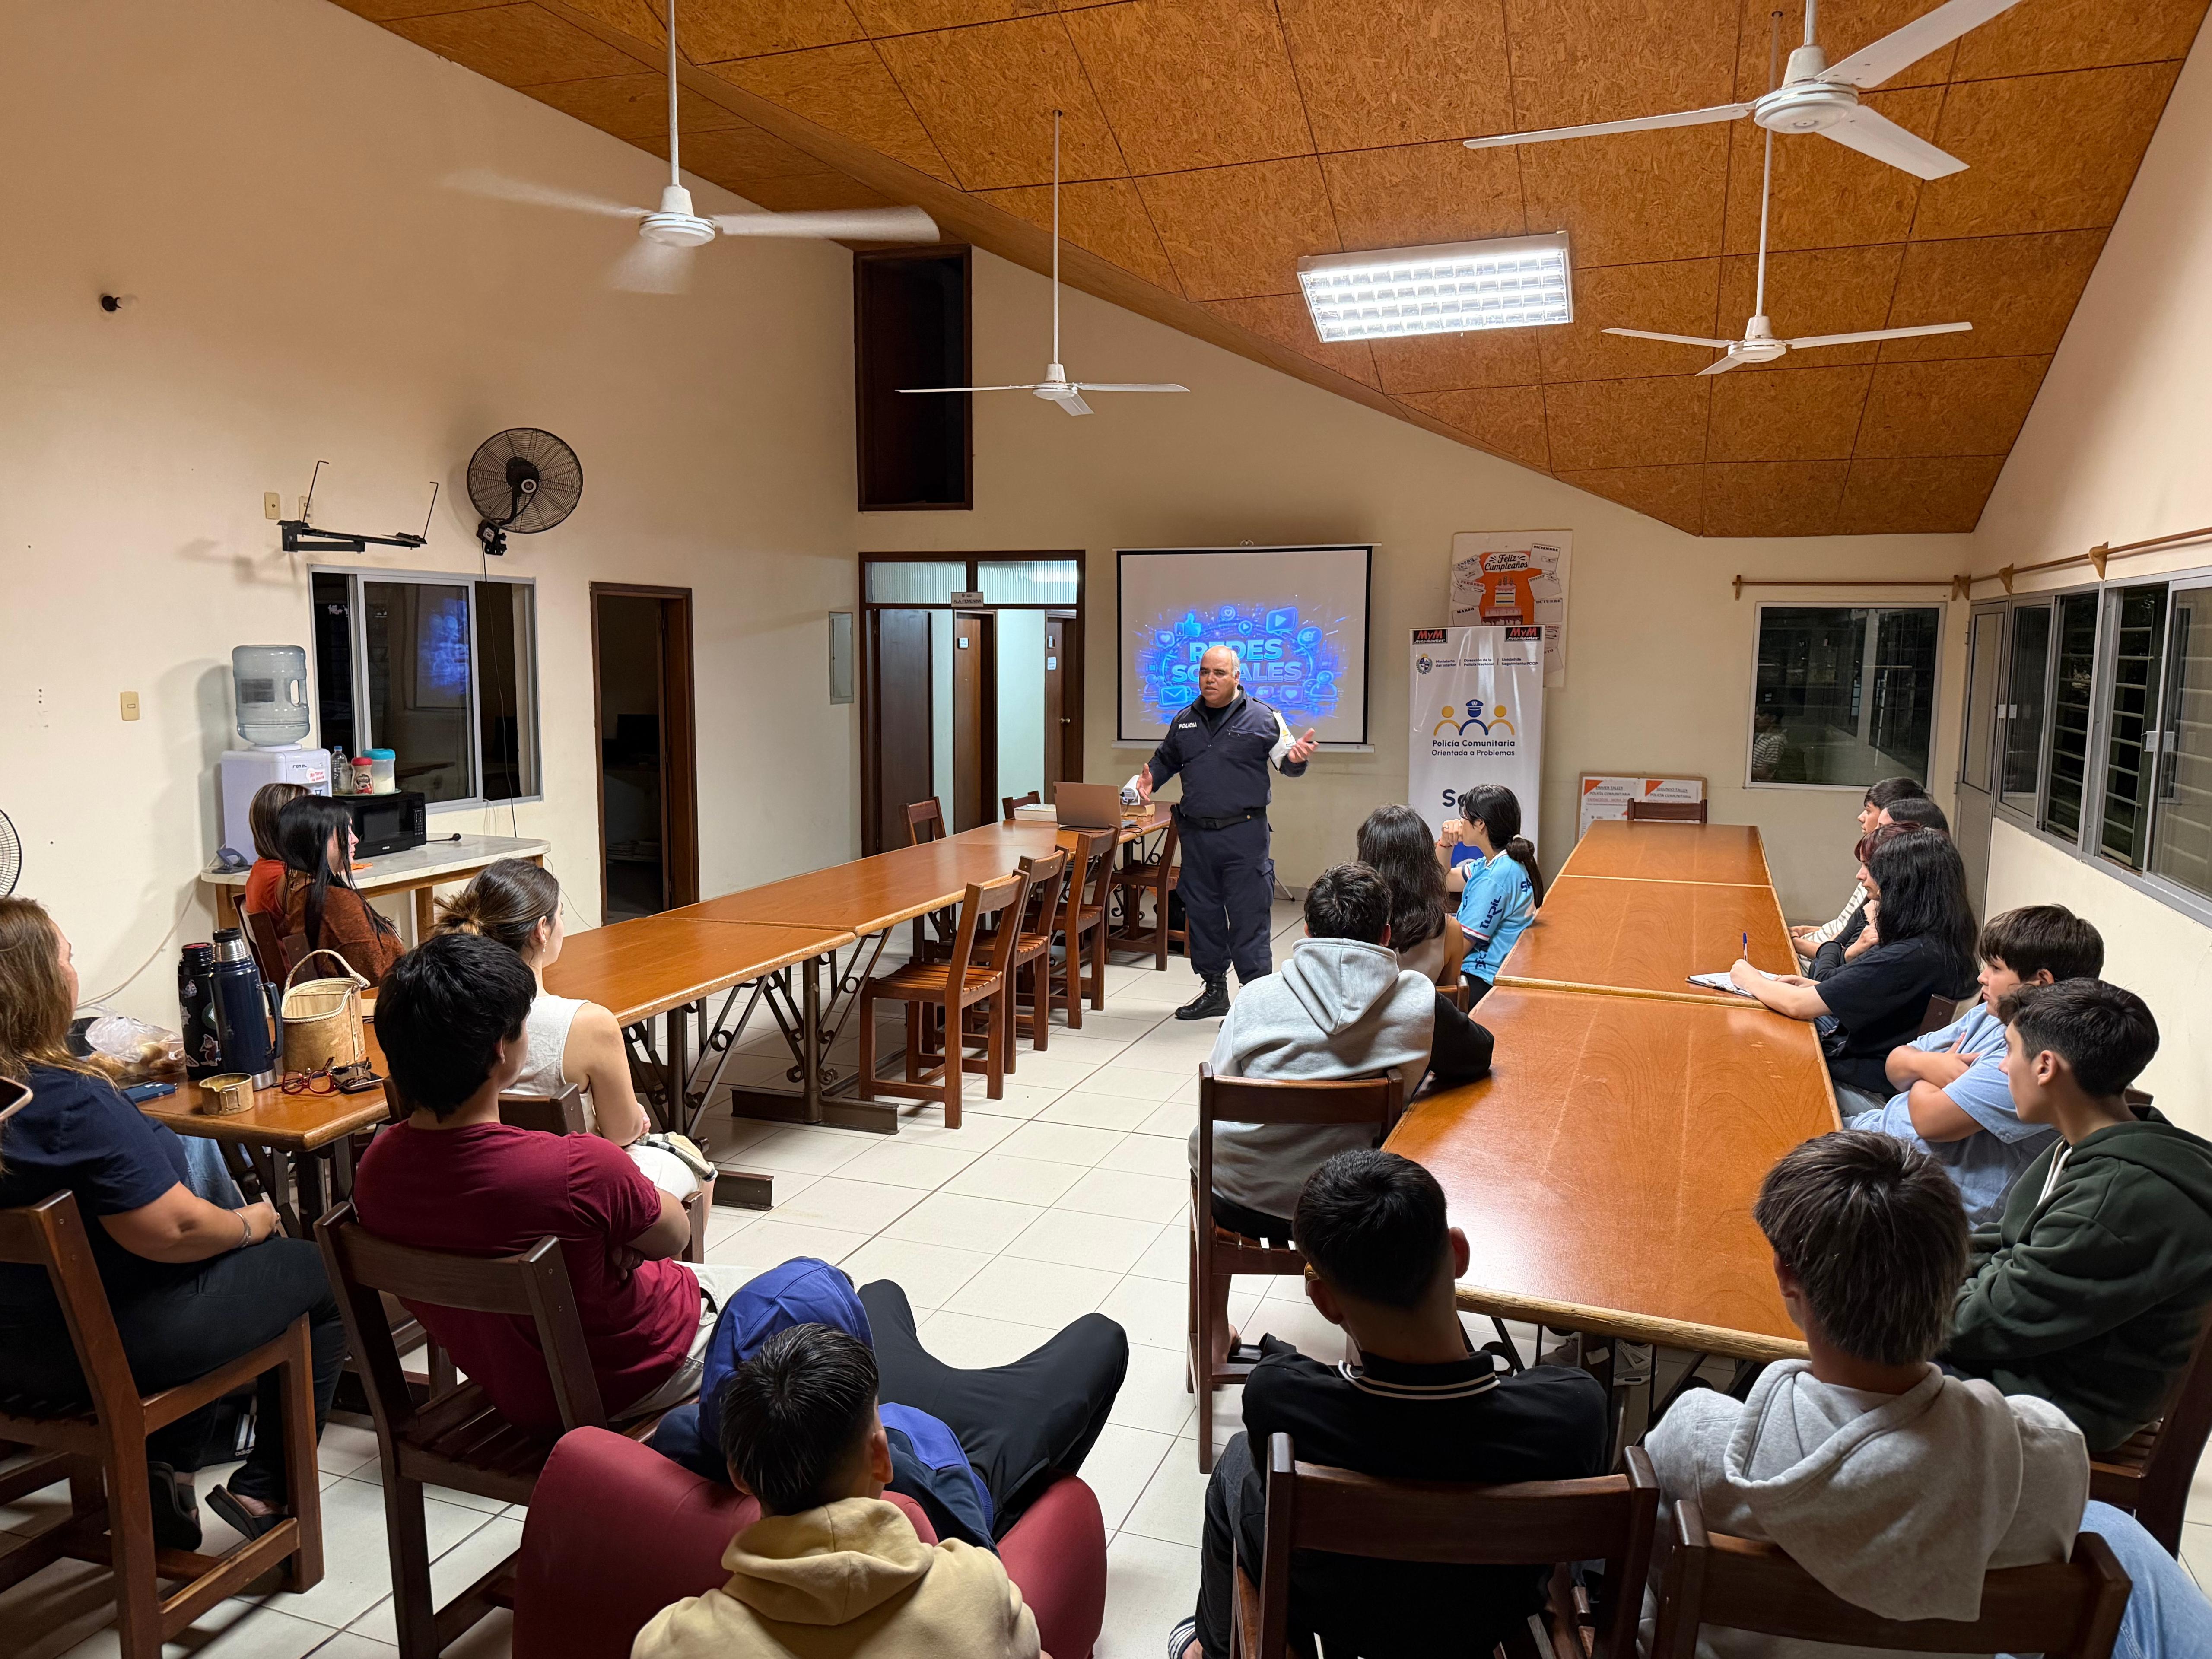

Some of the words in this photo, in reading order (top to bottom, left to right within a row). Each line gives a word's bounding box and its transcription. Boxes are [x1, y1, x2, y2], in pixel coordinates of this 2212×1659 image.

[1497, 554, 1517, 563] Feliz
[1484, 561, 1528, 572] Cumpleaños
[1417, 629, 1443, 640] MyM
[1510, 627, 1537, 637] MyM
[1171, 661, 1303, 683] SOALES
